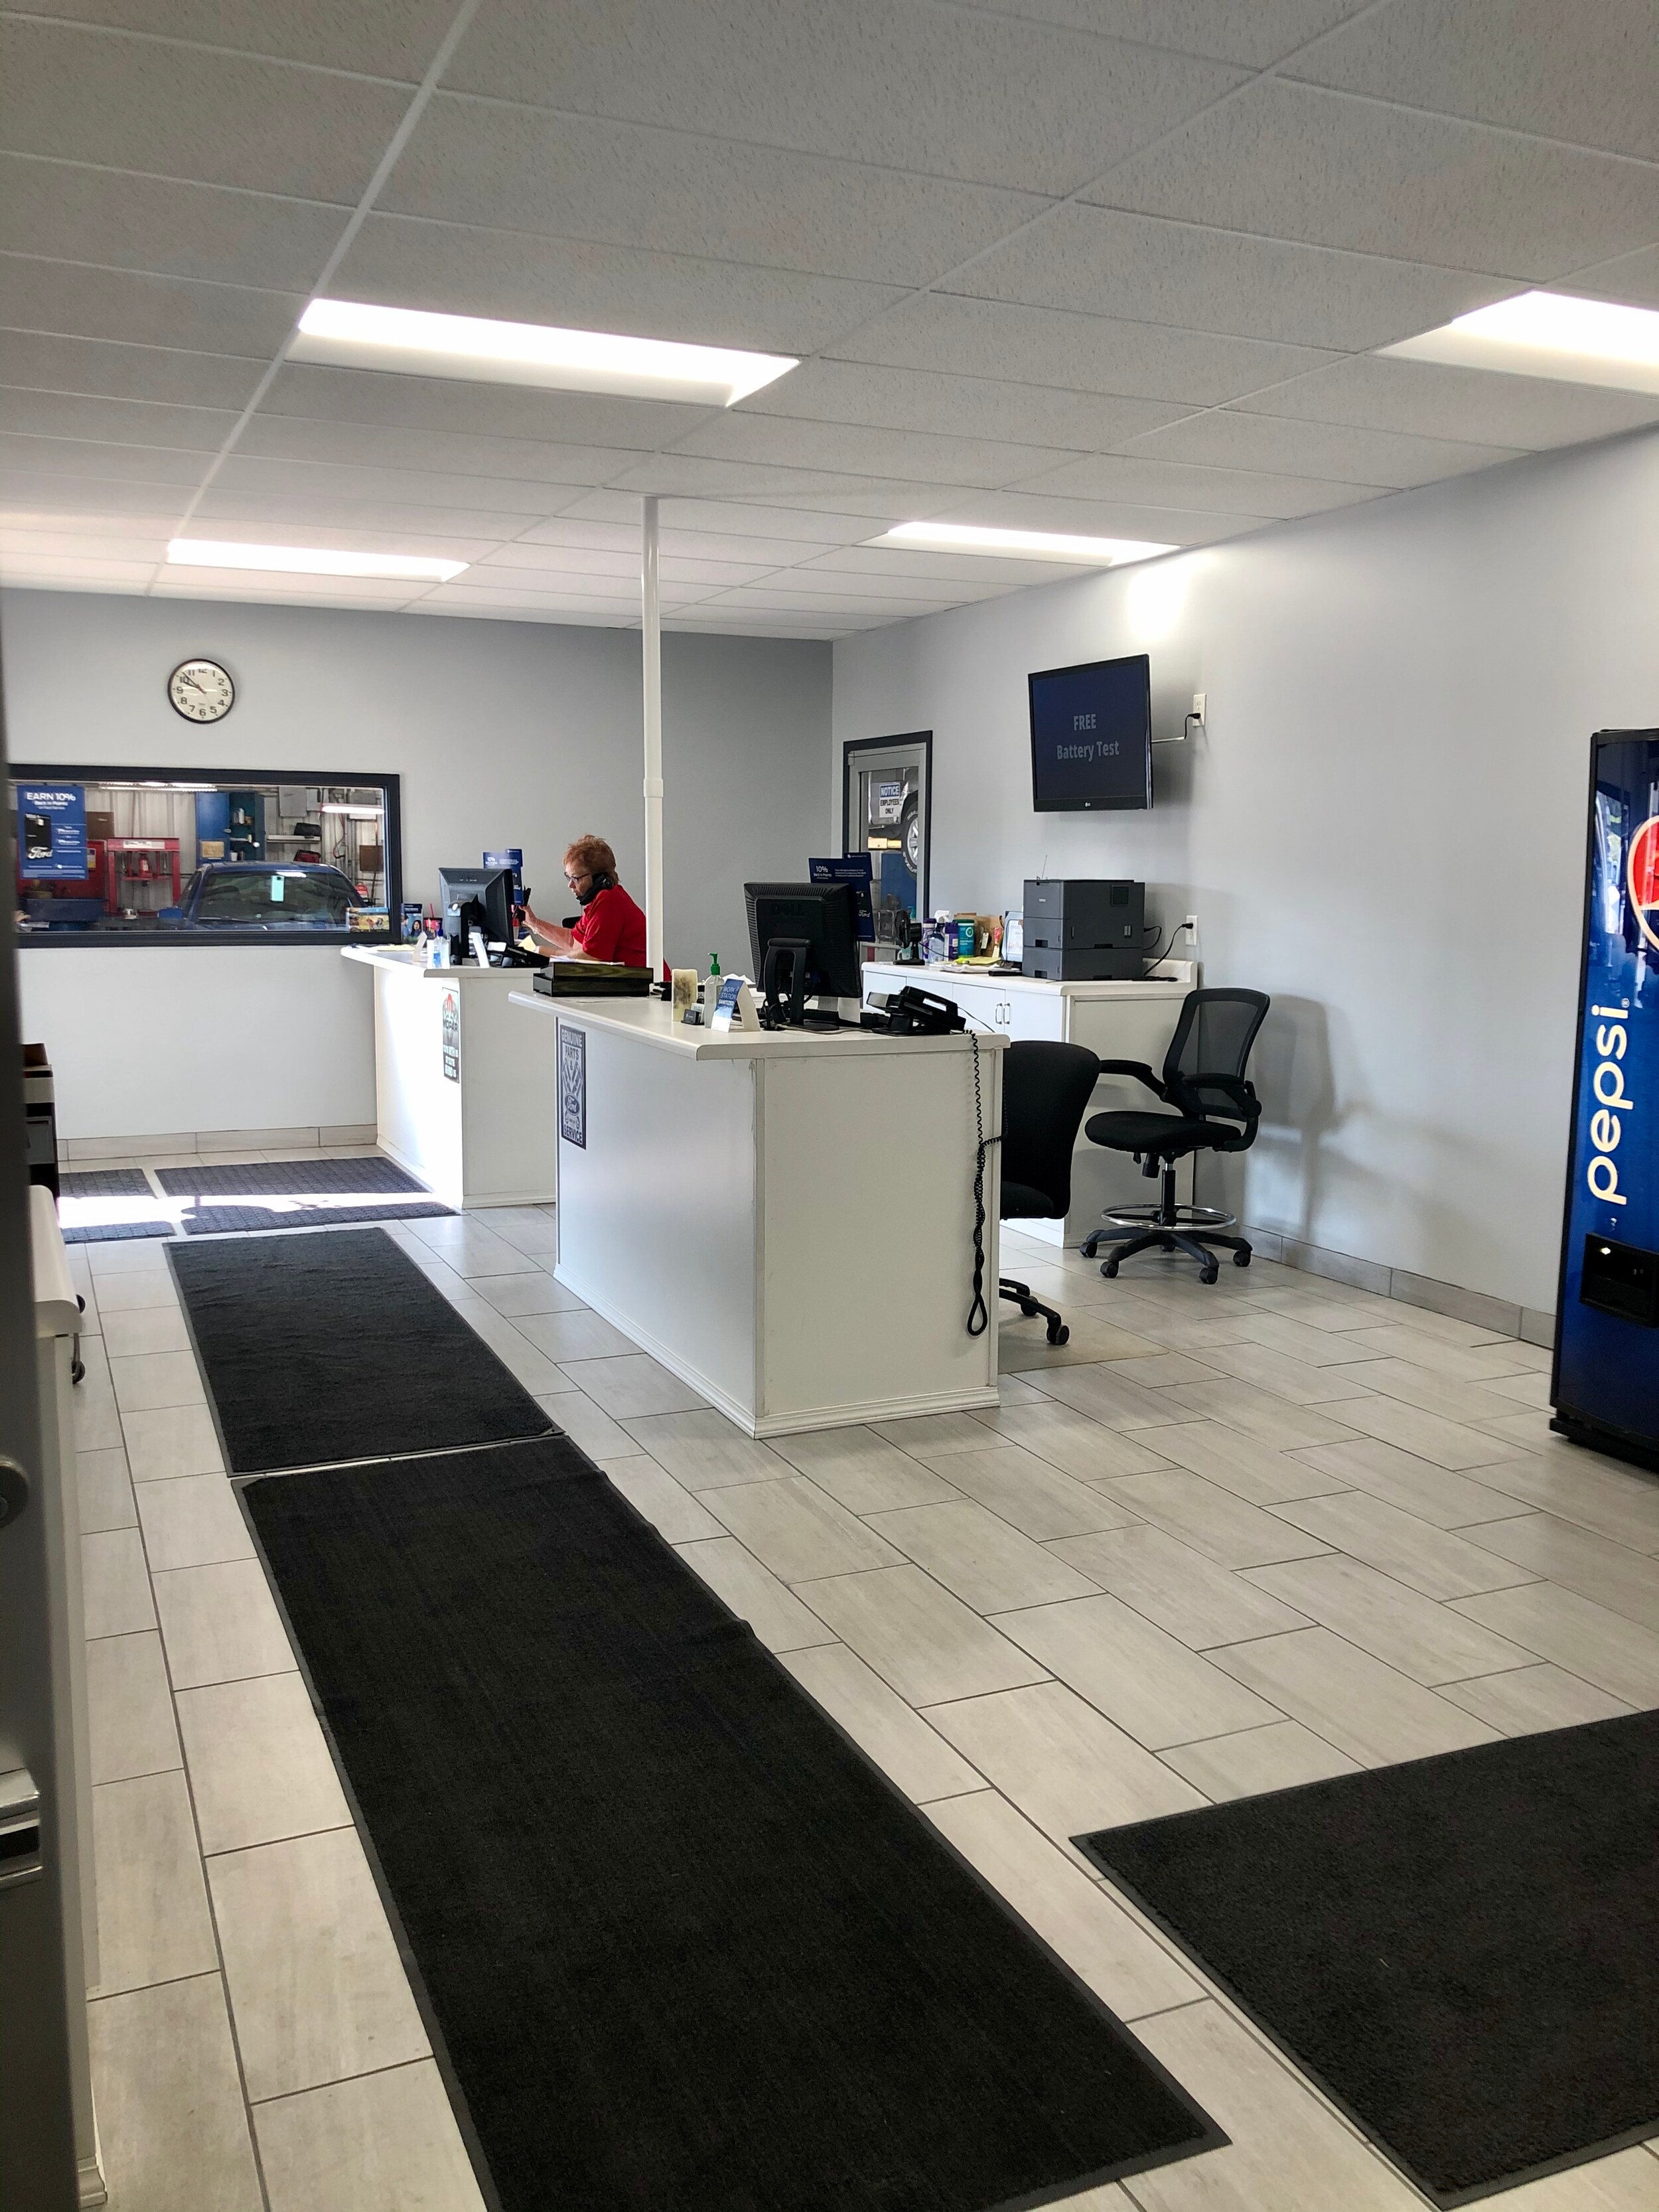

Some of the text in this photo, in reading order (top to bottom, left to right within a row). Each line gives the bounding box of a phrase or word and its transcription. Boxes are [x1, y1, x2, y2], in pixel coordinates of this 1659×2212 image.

[1072, 713, 1097, 731] FREE
[1056, 740, 1120, 762] Battery Test
[27, 792, 76, 802] EARN 10%
[881, 786, 899, 796] NOTICE
[28, 846, 53, 859] Ford
[858, 909, 871, 918] Ford
[561, 1029, 583, 1047] GENUINE
[565, 1045, 579, 1061] PARTS
[567, 1096, 577, 1112] Ford
[1587, 1004, 1634, 1206] pepsi
[563, 1124, 582, 1143] SERVICE
